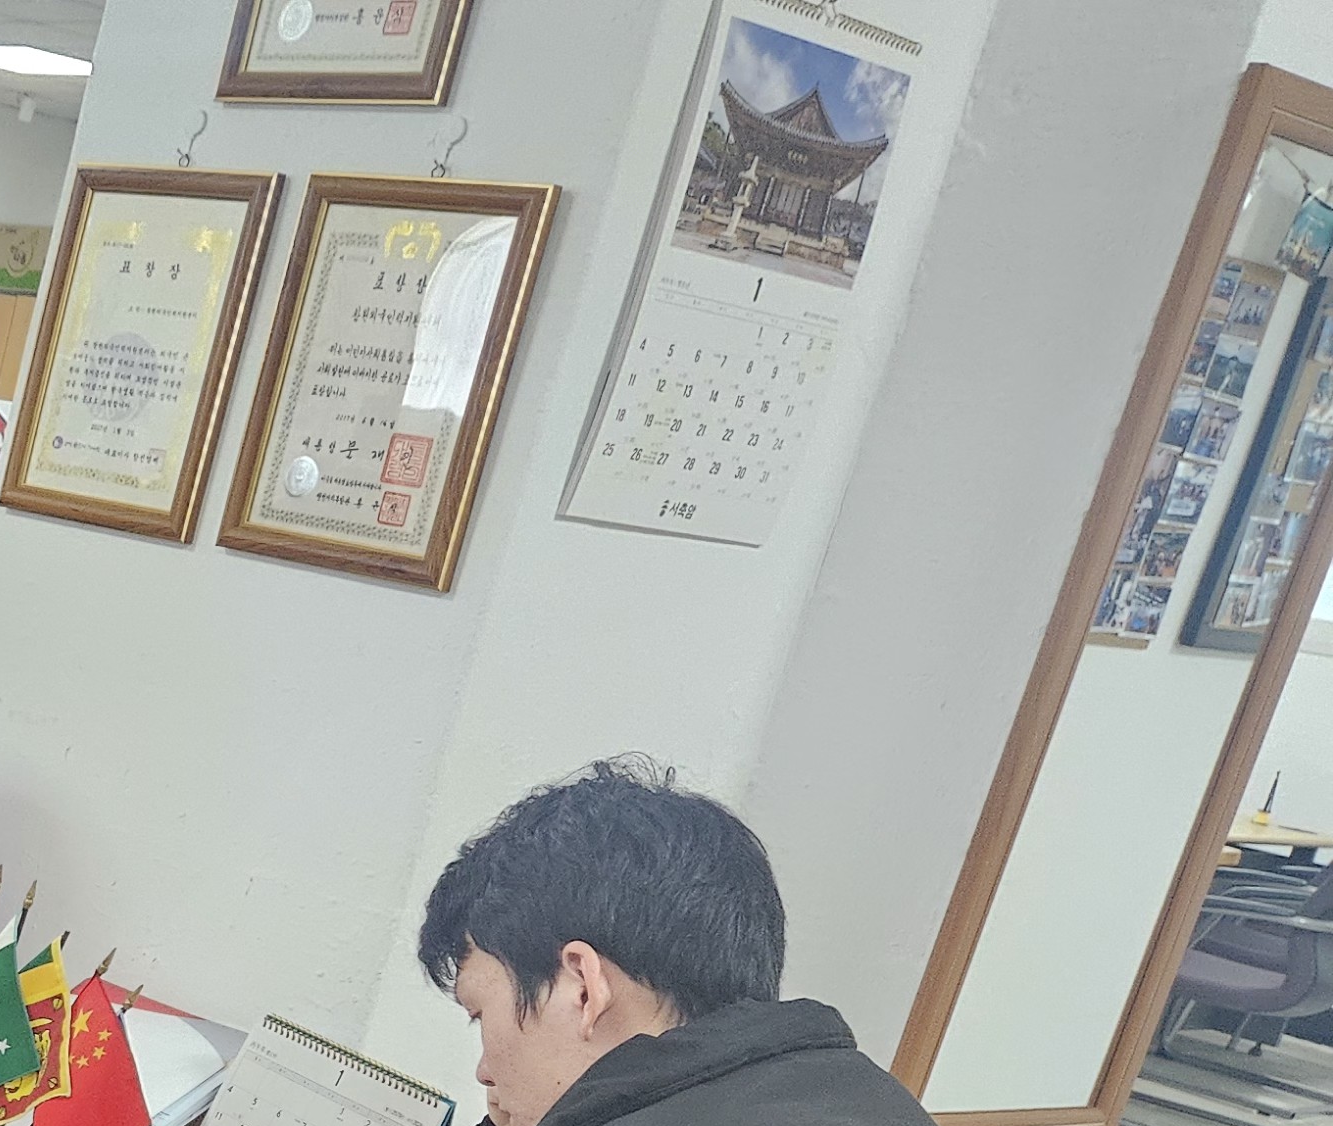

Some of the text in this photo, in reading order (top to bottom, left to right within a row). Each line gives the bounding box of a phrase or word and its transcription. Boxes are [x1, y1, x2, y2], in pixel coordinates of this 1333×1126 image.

[753, 277, 764, 302] 1
[757, 326, 764, 339] 1
[782, 332, 789, 345] 2
[639, 338, 647, 351] 4
[667, 344, 675, 357] 5
[694, 349, 702, 363] 6
[720, 355, 728, 368] 7
[746, 361, 754, 374] 8
[771, 366, 779, 380] 9
[628, 373, 795, 418] 11 12 13 14 15 16 17
[615, 408, 785, 451] 18 19 20 21 22 23 24
[602, 443, 770, 484] 25 26 27 28 29 30 31
[334, 1069, 345, 1087] 1
[214, 1111, 223, 1121] 11
[252, 1098, 258, 1106] 5
[276, 1110, 281, 1118] 6
[339, 1107, 346, 1115] 1
